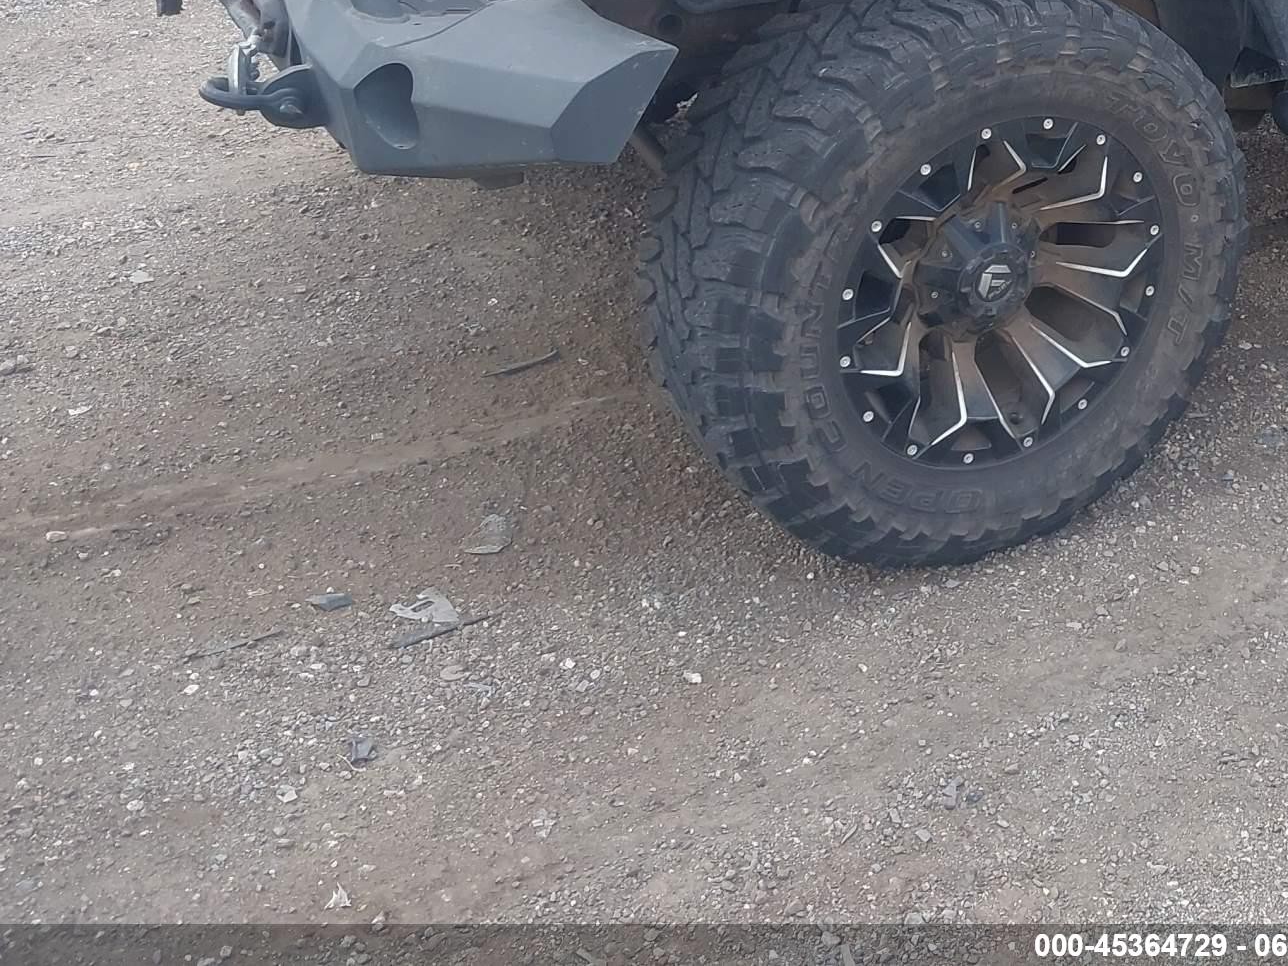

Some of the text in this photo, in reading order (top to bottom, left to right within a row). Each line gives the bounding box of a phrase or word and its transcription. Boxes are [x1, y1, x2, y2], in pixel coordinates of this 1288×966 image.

[1107, 93, 1204, 346] TOYO M/T
[851, 461, 984, 515] OPEN
